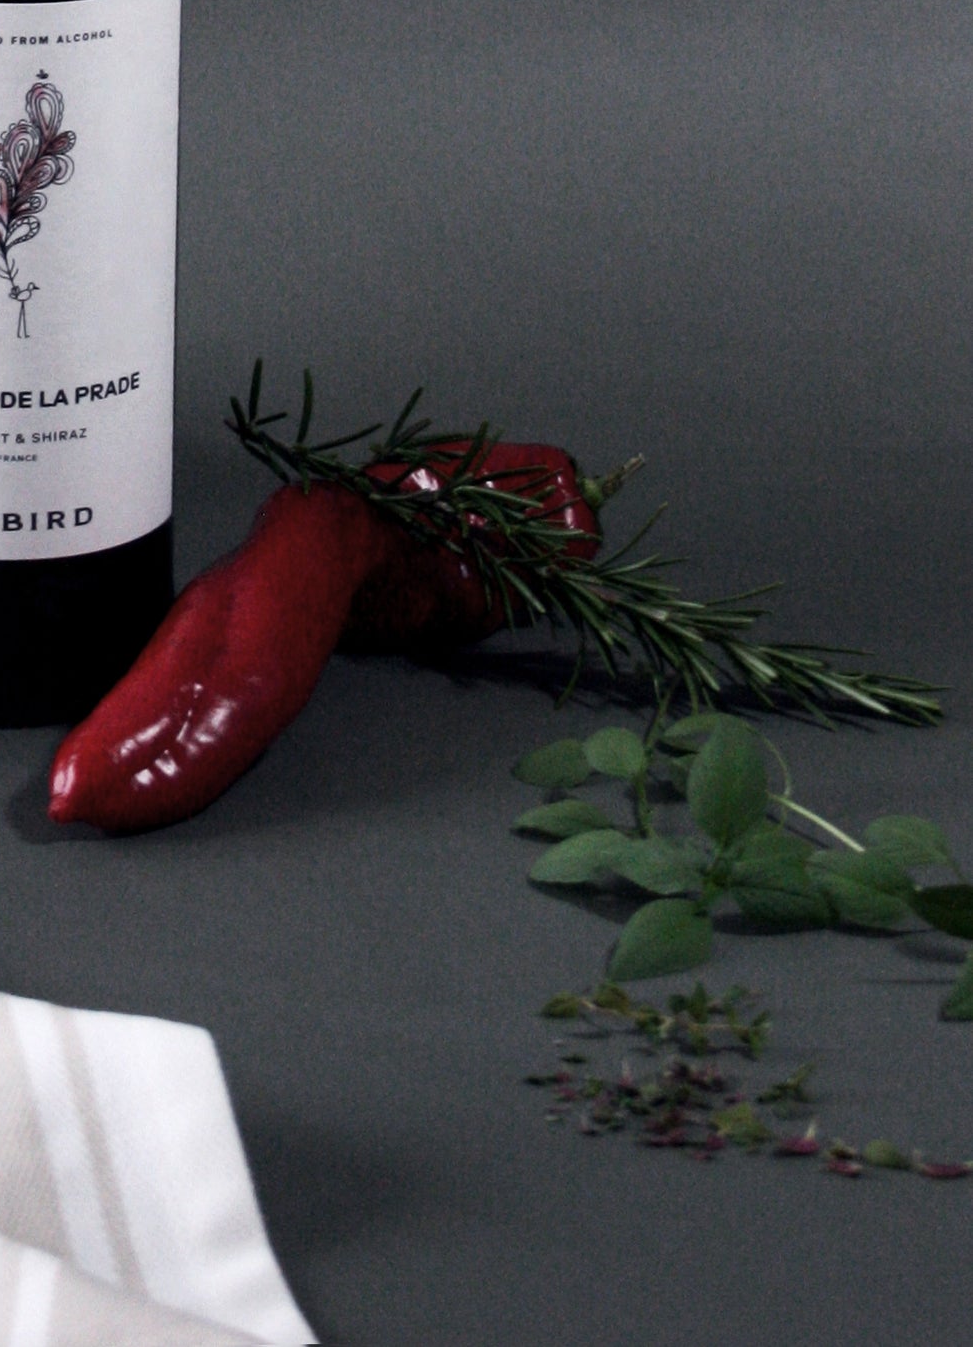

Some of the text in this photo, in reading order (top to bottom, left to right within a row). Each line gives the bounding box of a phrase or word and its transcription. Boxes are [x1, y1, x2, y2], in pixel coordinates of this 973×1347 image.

[11, 36, 49, 45] FROM
[57, 29, 113, 44] ALCOHOL
[0, 390, 32, 409] DE
[38, 389, 69, 408] LA
[74, 371, 140, 405] PRADE
[15, 433, 26, 444] &
[32, 427, 88, 444] SHIRAZ
